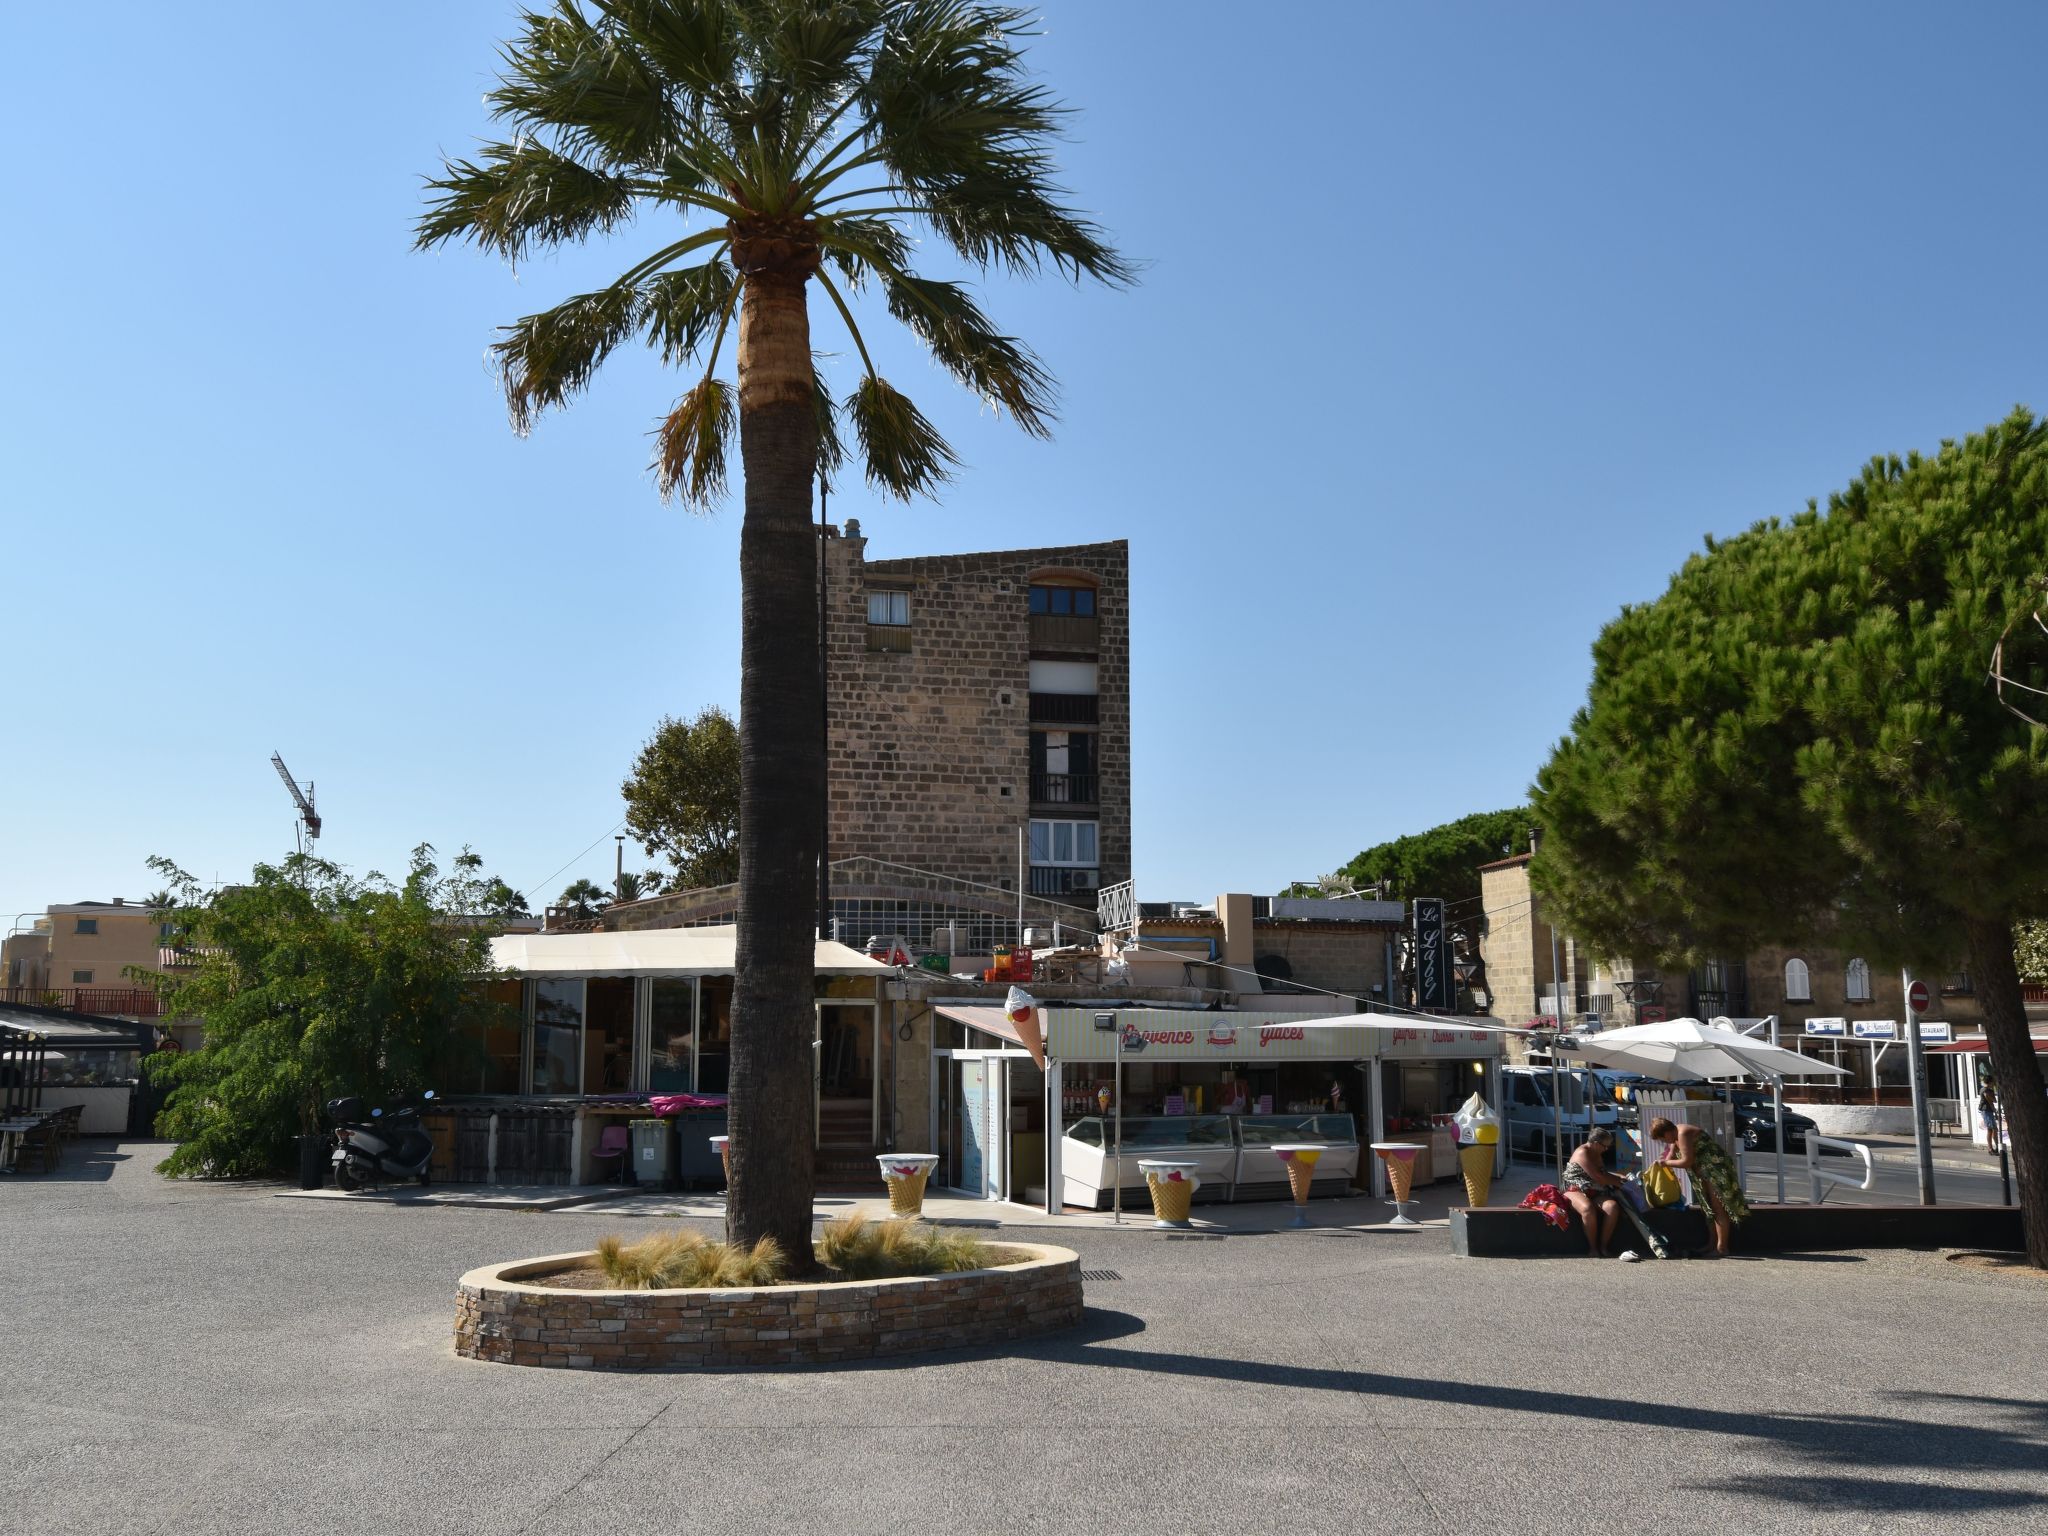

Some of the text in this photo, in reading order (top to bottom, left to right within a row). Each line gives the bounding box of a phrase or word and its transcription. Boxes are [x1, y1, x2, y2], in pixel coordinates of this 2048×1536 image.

[1420, 906, 1439, 922] Le
[1420, 929, 1440, 1000] Label
[1120, 1024, 1195, 1045] Povence
